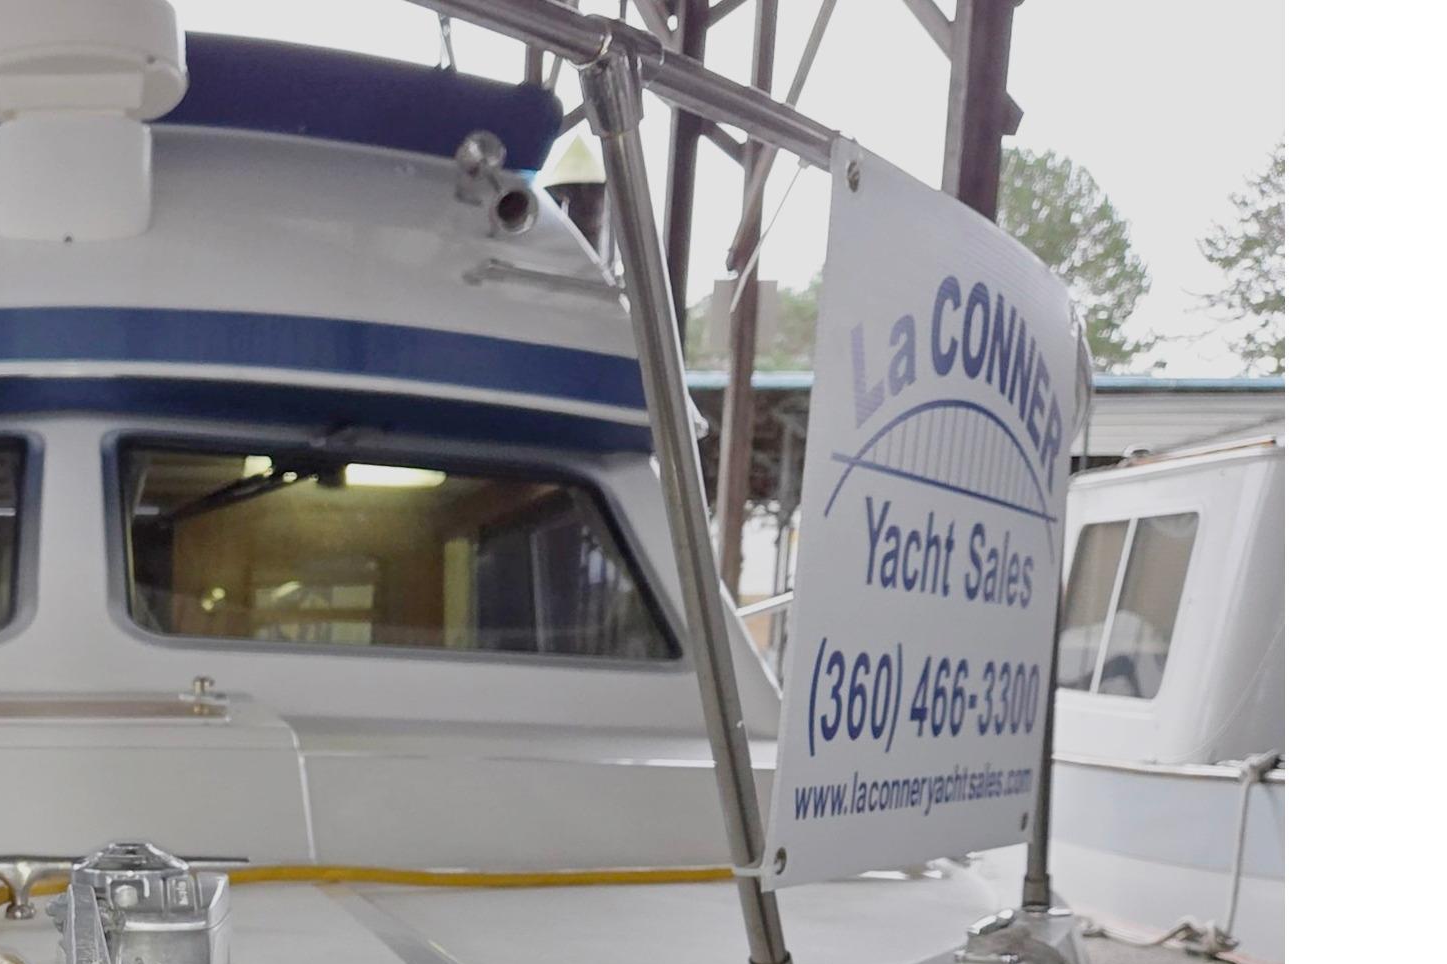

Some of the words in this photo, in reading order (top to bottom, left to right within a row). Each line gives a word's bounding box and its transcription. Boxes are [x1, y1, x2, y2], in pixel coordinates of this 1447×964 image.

[850, 313, 917, 430] La
[931, 275, 1062, 494] CONNER
[866, 496, 955, 597] Yacht
[965, 522, 1033, 609] Sales
[809, 637, 902, 757] (360)
[910, 656, 1039, 738] 466-3300
[795, 763, 1032, 821] www.laconneryachtsales.com
